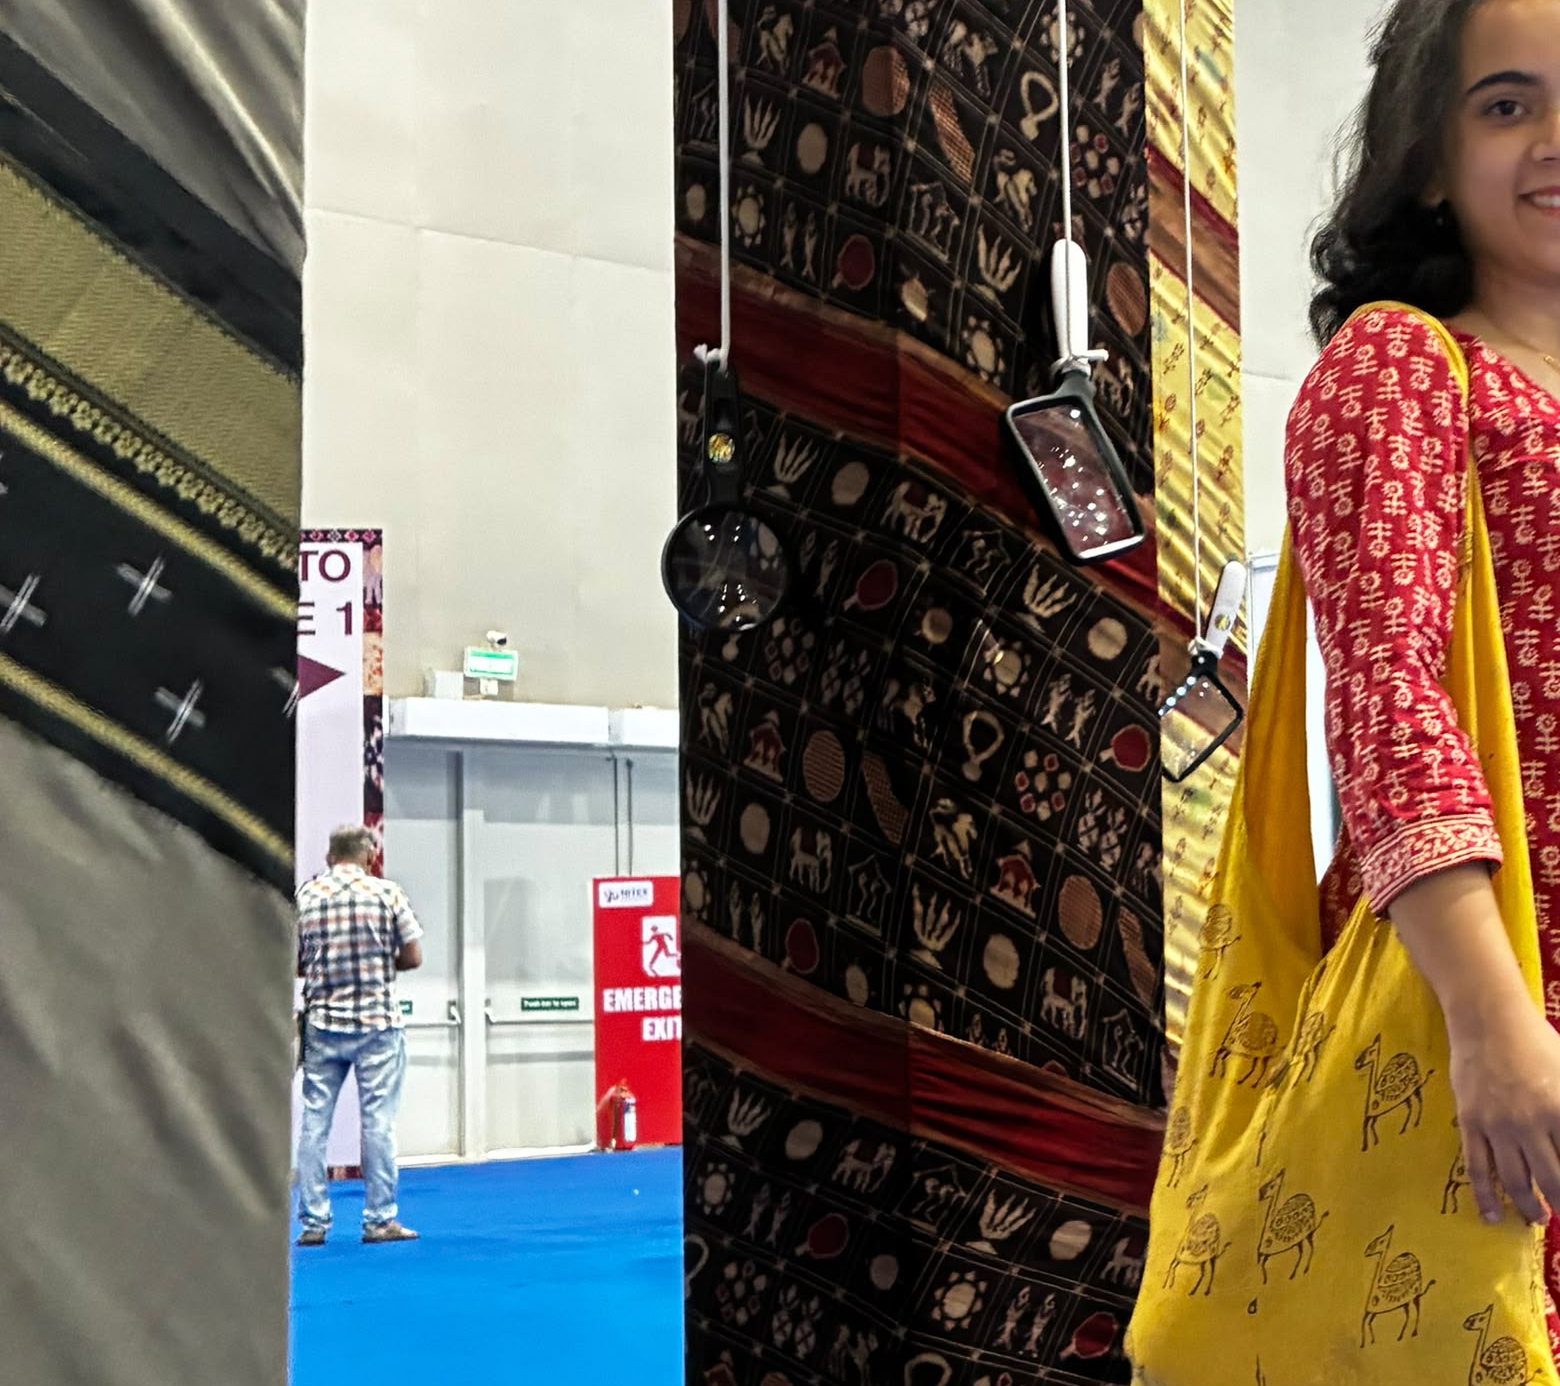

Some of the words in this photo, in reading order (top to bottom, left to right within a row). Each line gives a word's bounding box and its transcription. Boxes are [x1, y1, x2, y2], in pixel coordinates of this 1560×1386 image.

[299, 549, 352, 583] TO
[336, 601, 353, 636] 1
[643, 1015, 682, 1041] EXIT
